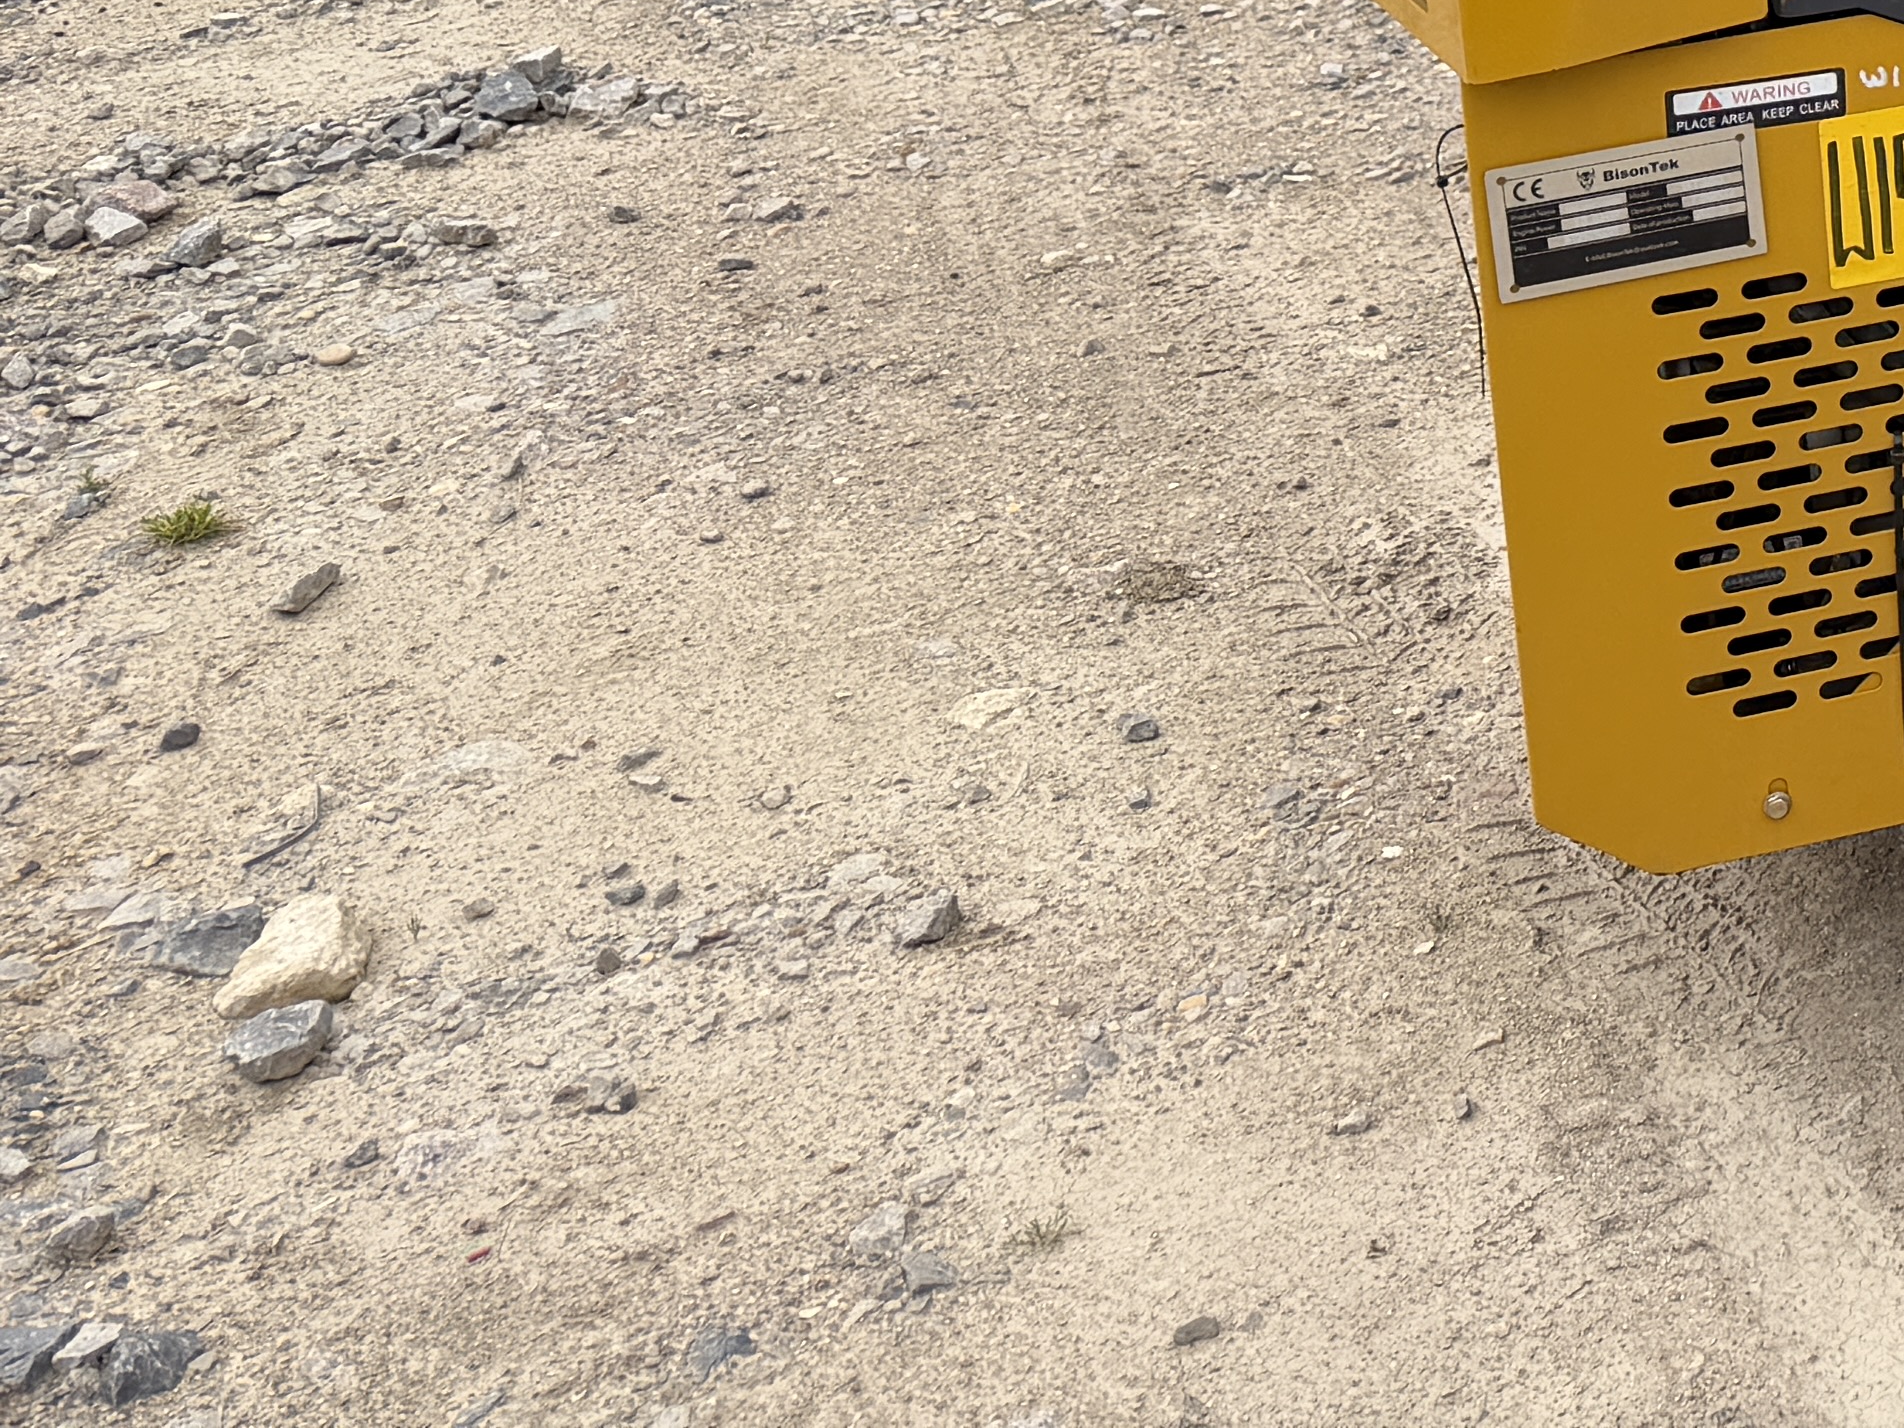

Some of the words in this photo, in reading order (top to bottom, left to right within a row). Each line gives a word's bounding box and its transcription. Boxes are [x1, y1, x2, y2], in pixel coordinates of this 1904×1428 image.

[1731, 81, 1811, 105] WARING
[1676, 116, 1716, 132] PLACE
[1720, 111, 1754, 126] AREA
[1762, 105, 1794, 120] KEEP
[1799, 99, 1839, 115] CLEAR
[1602, 158, 1680, 183] BisonTek
